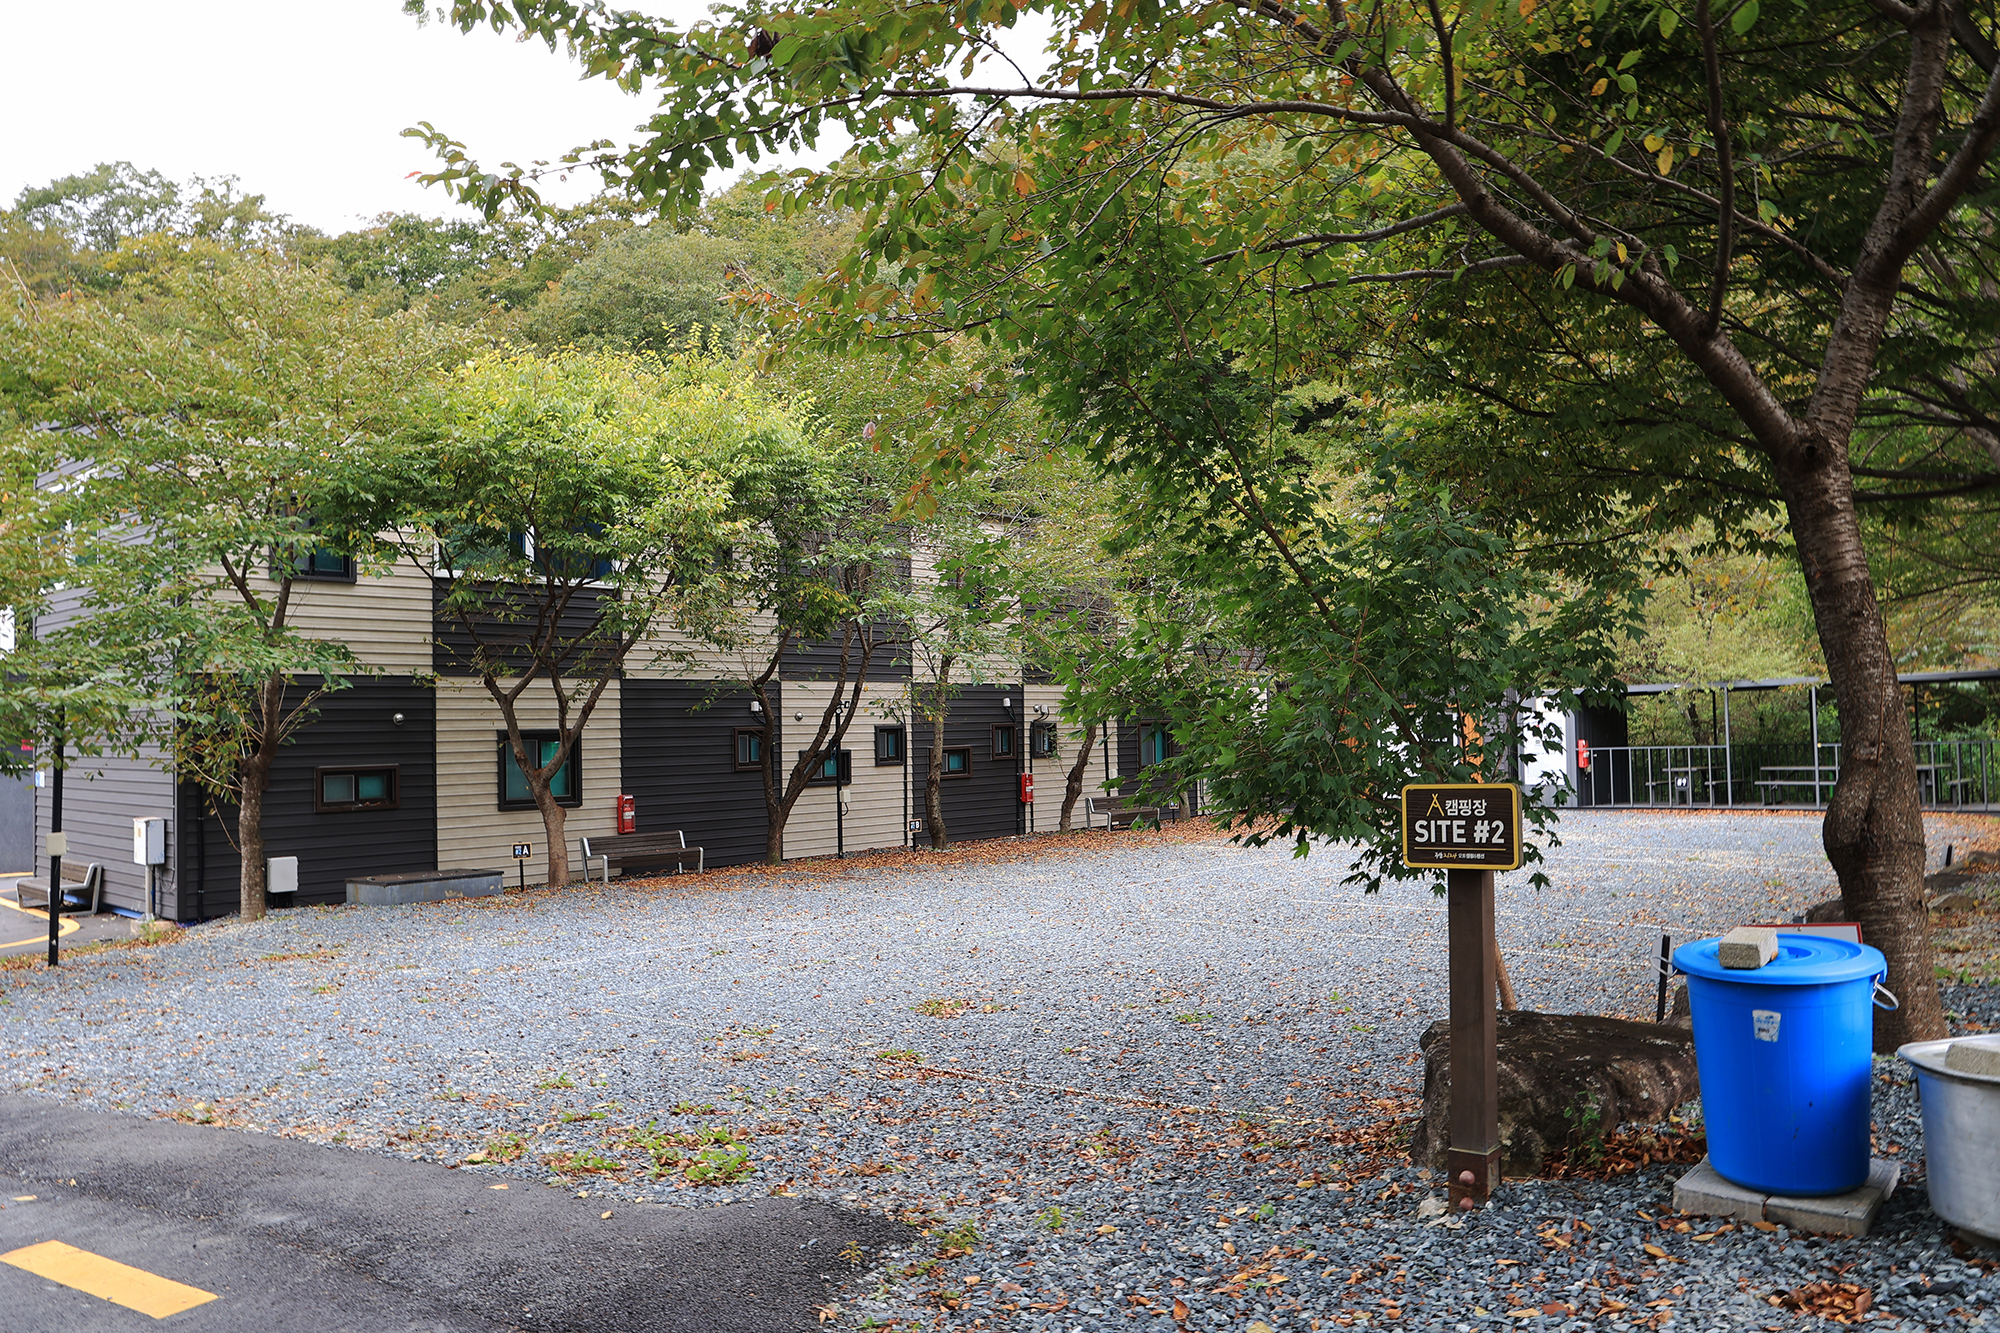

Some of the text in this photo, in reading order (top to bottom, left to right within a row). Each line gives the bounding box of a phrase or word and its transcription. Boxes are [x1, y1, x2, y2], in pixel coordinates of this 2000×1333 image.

[1445, 799, 1487, 816] 캠핑장
[1414, 820, 1505, 844] SITE #2
[522, 845, 529, 855] A
